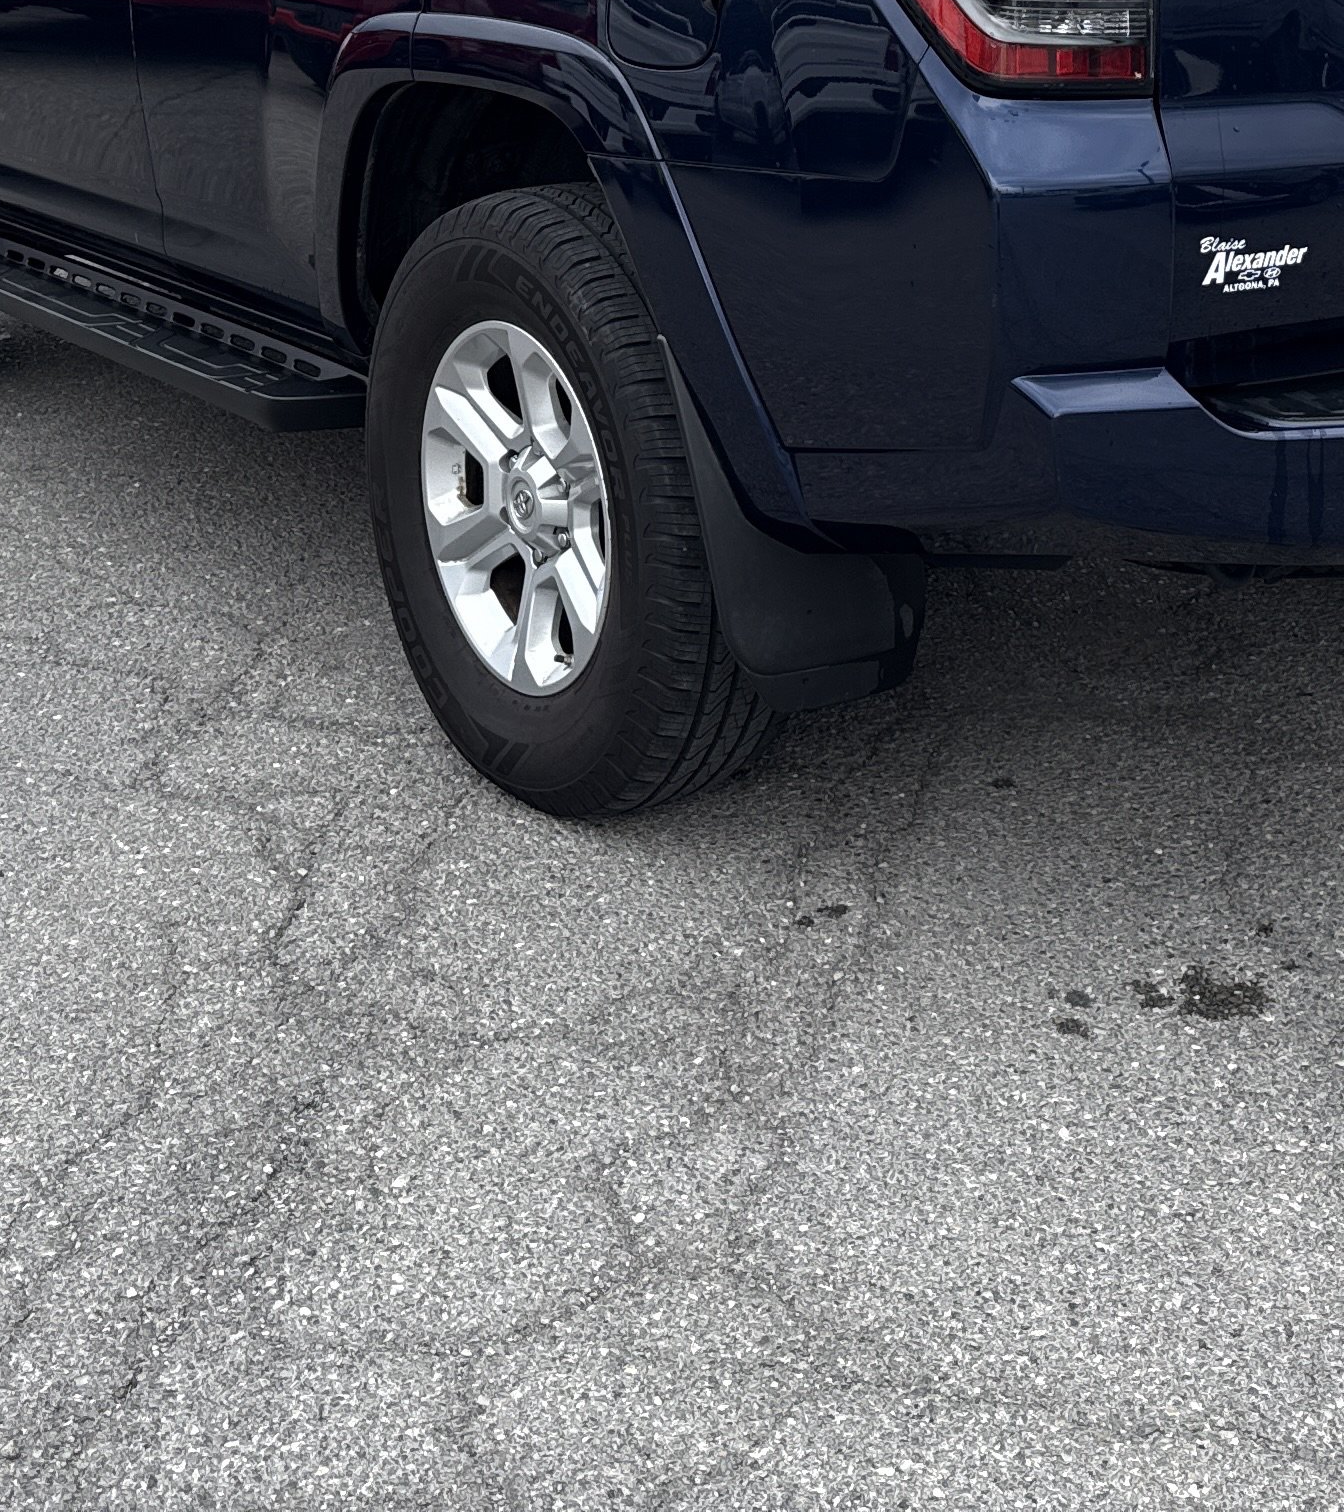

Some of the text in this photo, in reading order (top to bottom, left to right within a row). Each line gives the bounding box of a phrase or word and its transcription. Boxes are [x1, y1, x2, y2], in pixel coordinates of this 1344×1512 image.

[1200, 236, 1247, 254] Blaise
[1201, 245, 1308, 286] Alexander
[1222, 278, 1280, 293] ALTOONA, PA
[515, 273, 628, 501] ENDEAVOR
